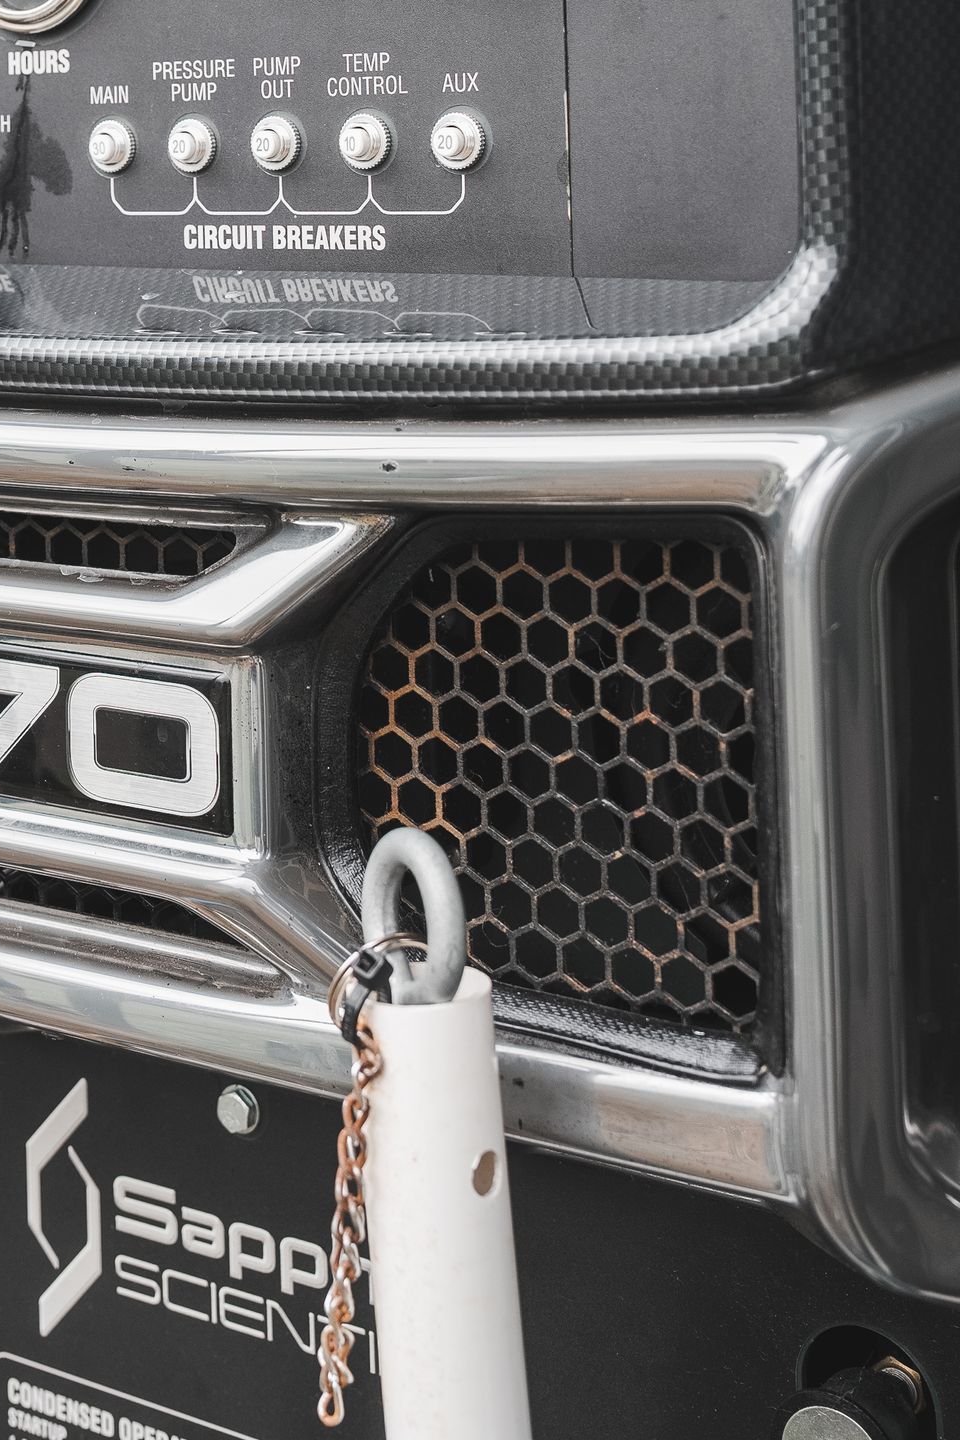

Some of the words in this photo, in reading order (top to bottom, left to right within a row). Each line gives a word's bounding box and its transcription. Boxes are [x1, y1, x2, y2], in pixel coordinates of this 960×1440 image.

[7, 48, 71, 77] HOURS
[152, 58, 236, 81] PRESSURE
[252, 56, 301, 77] PUMP
[342, 52, 391, 73] TEMP
[170, 82, 218, 102] PUMP
[260, 78, 294, 99] OUT
[327, 75, 409, 98] CONTROL
[442, 72, 479, 93] AUX
[89, 84, 129, 105] MAIN
[92, 141, 106, 157] 30
[172, 139, 187, 154] 20
[255, 137, 270, 153] 20
[344, 136, 356, 152] 10
[437, 134, 453, 150] 20
[183, 224, 268, 250] CIRCUIT
[273, 226, 387, 251] BREAKERS
[7, 1377, 115, 1438] CONDENSED
[7, 1407, 68, 1440] STARTUP
